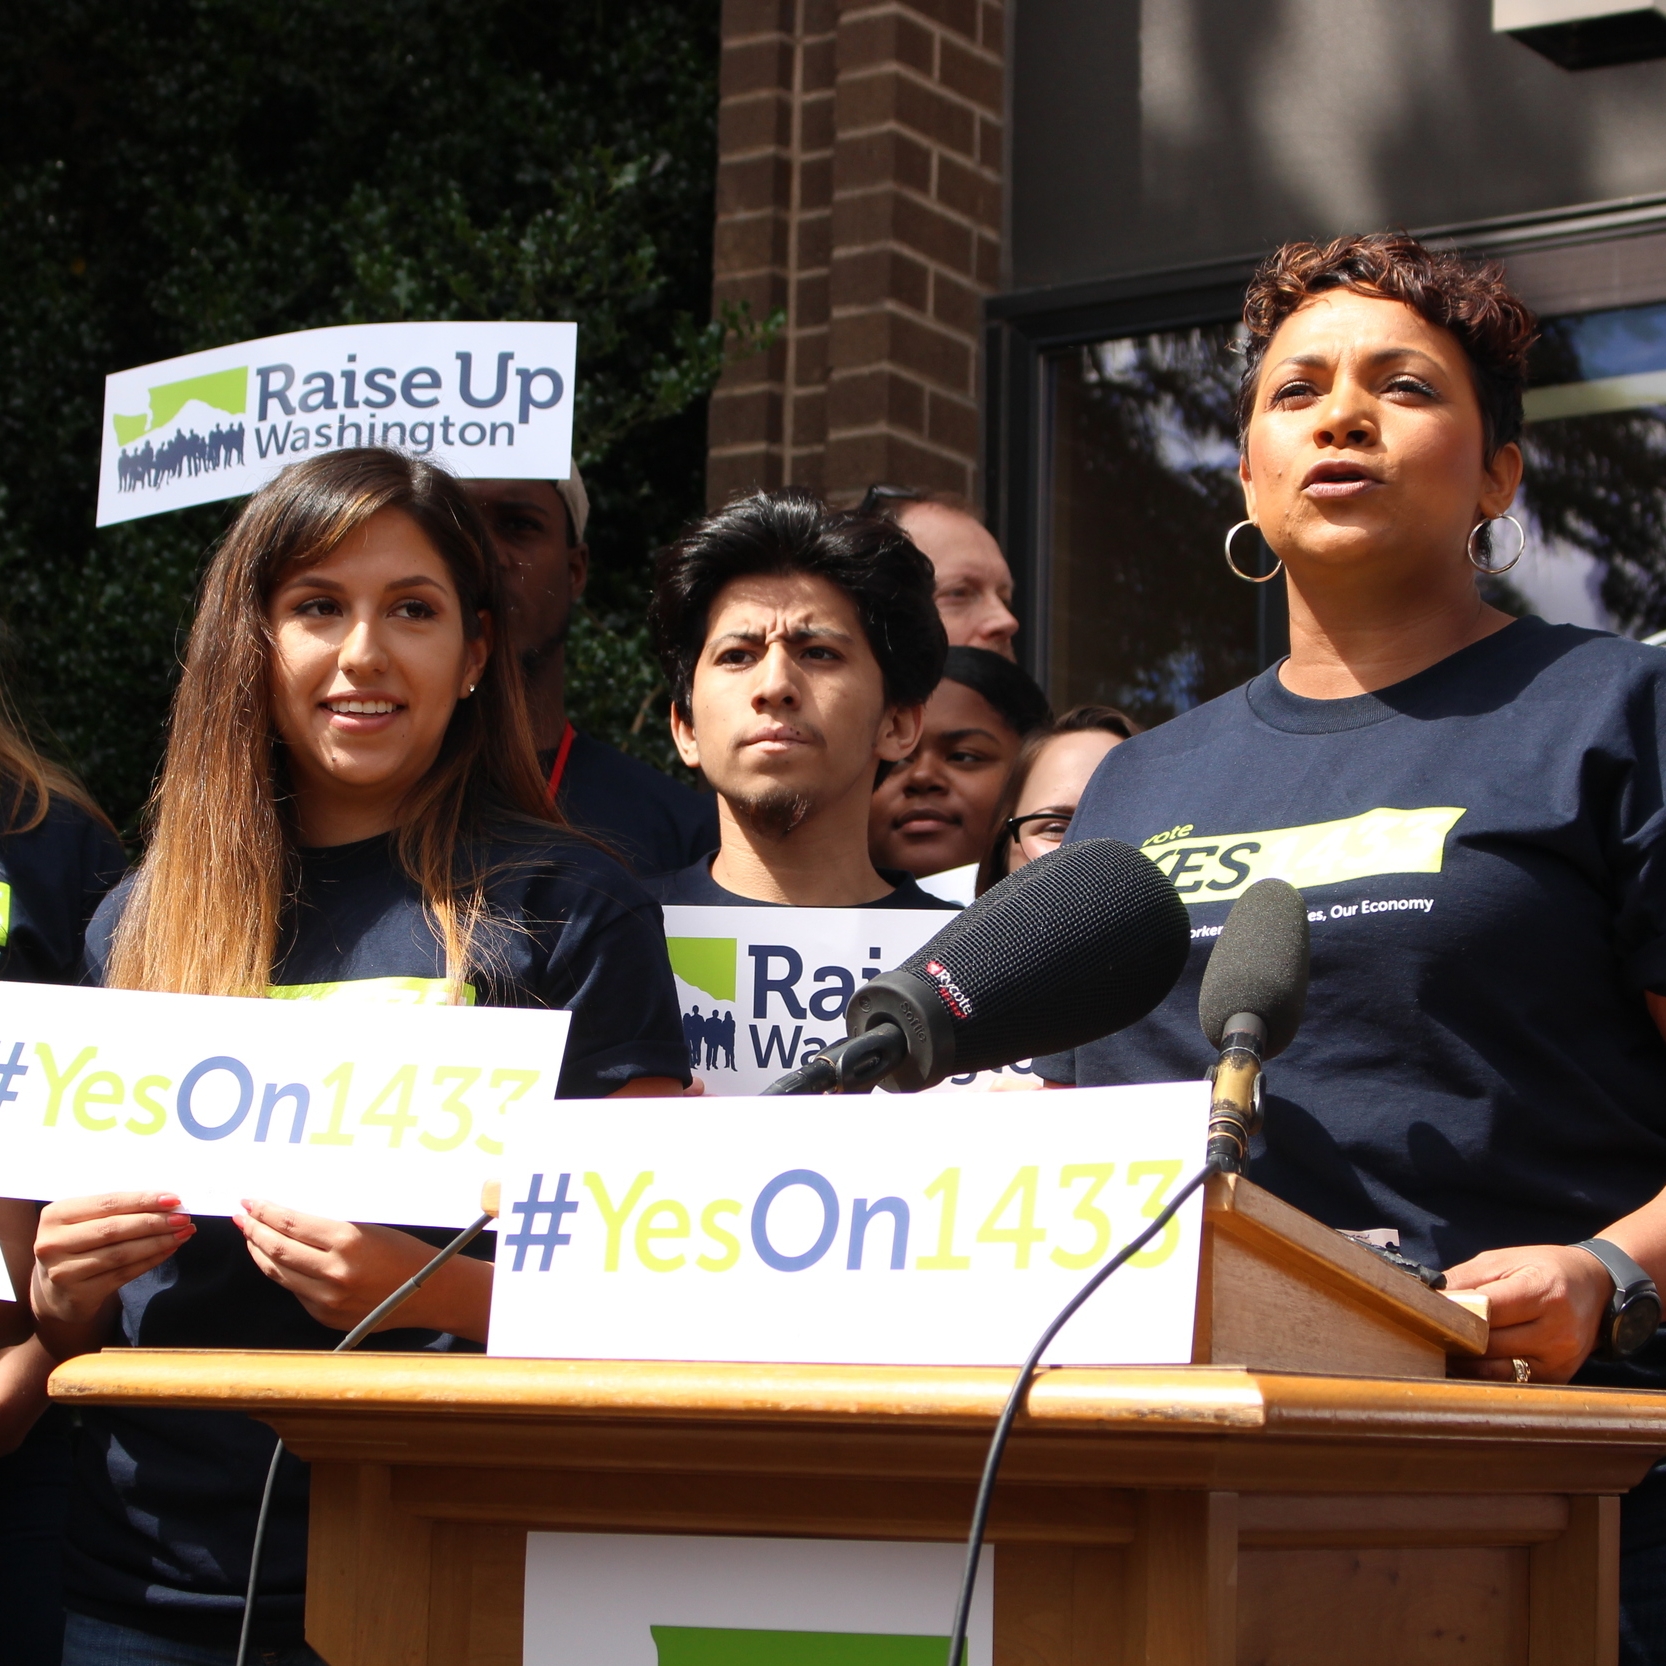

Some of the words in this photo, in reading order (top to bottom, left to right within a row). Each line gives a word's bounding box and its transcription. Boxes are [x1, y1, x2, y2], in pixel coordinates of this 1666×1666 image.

[255, 353, 442, 422] Raise
[455, 351, 565, 424] Up
[255, 413, 515, 459] Washington
[1142, 824, 1194, 847] vote
[1266, 813, 1453, 883] 1433
[1306, 910, 1327, 922] es,
[1330, 904, 1359, 919] Our
[1361, 898, 1434, 914] Economy
[936, 968, 974, 1016] Rycote
[0, 1041, 541, 1156] #YesOn1433
[504, 1159, 1184, 1273] #YesOn1433
